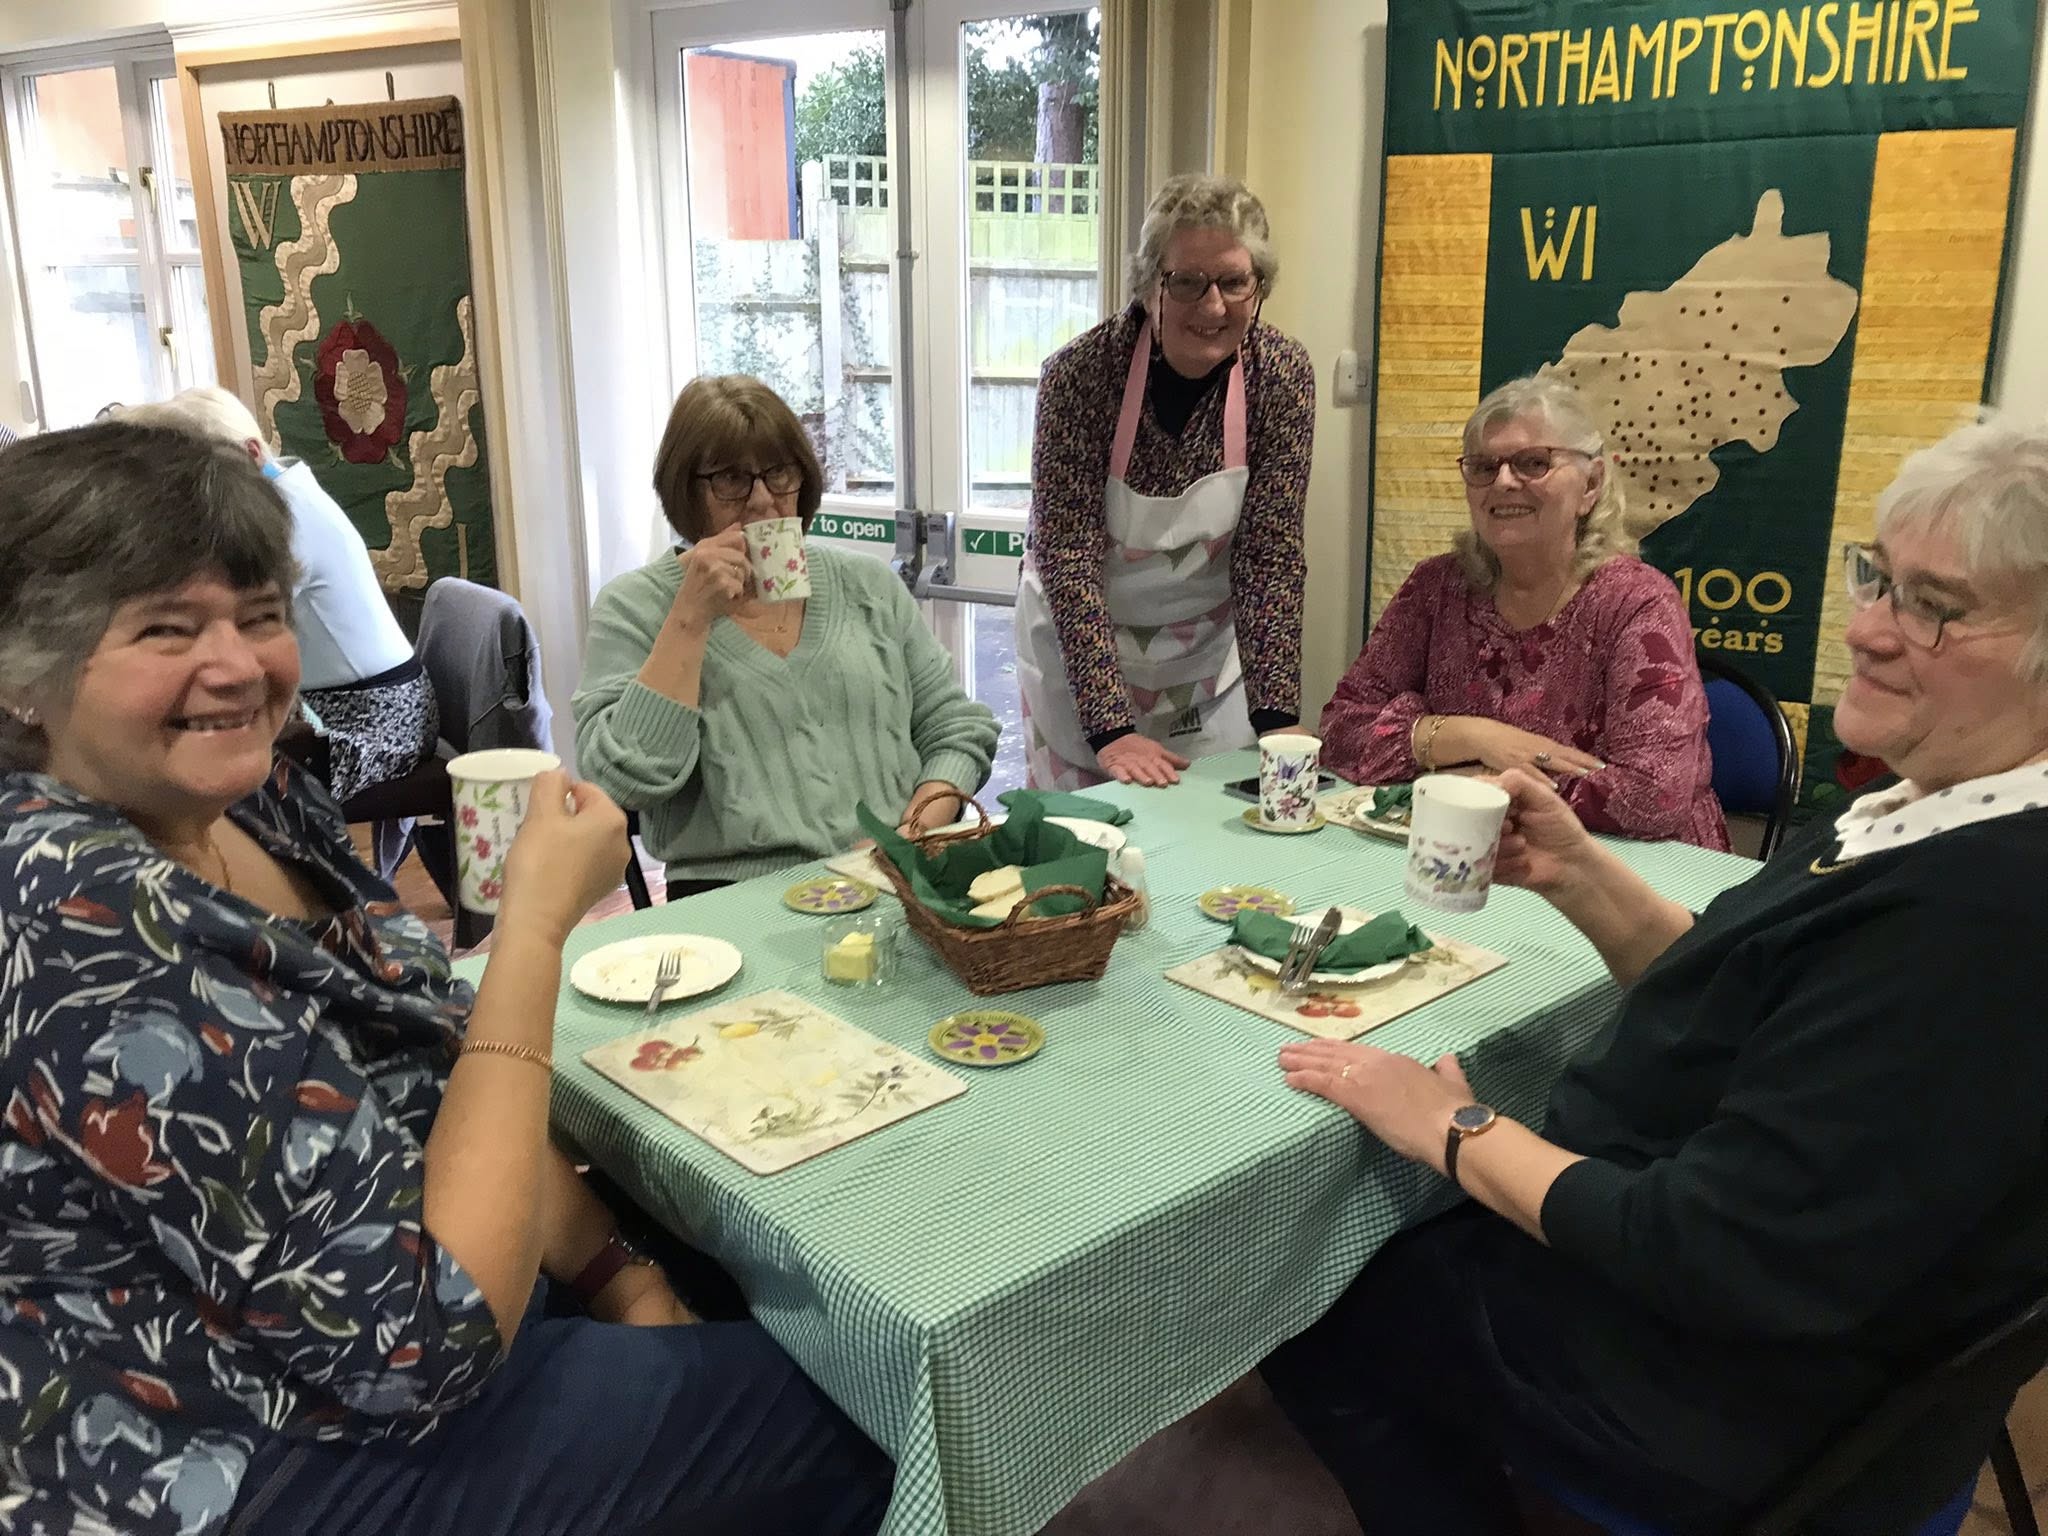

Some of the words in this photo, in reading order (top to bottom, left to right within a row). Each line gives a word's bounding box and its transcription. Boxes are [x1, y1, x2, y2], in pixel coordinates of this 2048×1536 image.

[1433, 0, 1979, 111] NORTHAMPTONSHIRE
[221, 109, 463, 166] NORTHAMPTONSHIRE
[229, 180, 282, 251] W
[1520, 205, 1598, 281] WI
[820, 516, 838, 533] to
[842, 521, 886, 539] open
[1674, 567, 1792, 614] 100
